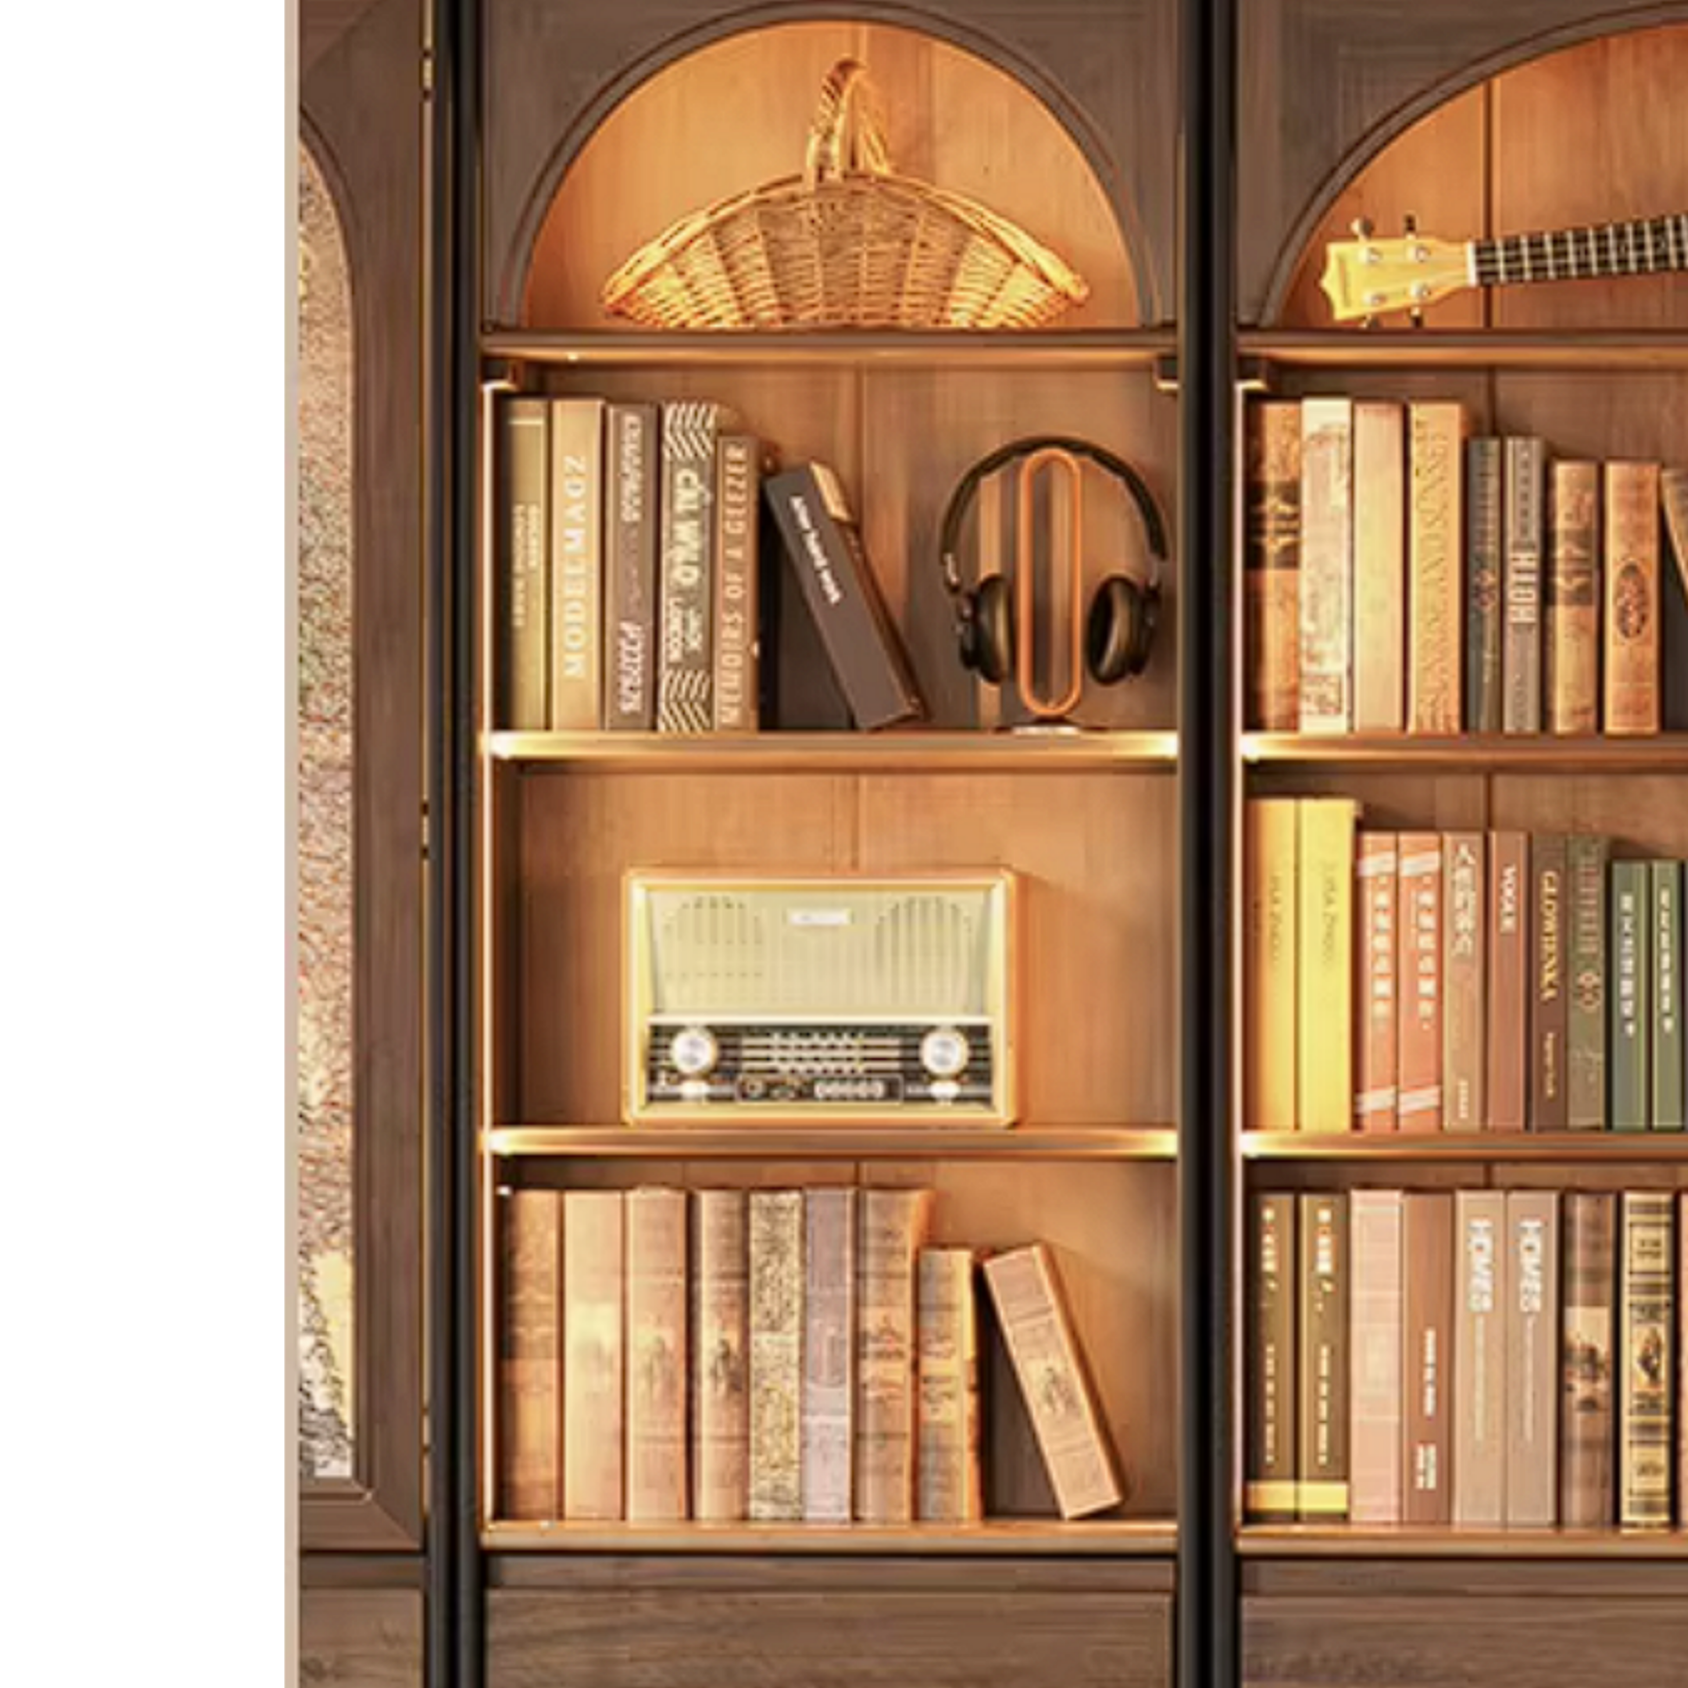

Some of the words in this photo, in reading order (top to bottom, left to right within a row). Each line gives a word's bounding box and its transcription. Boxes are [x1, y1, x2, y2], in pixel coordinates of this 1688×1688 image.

[720, 444, 745, 534] GEEZER
[720, 543, 744, 560] A
[719, 572, 744, 601] OF
[718, 612, 744, 727] MEMOIRS
